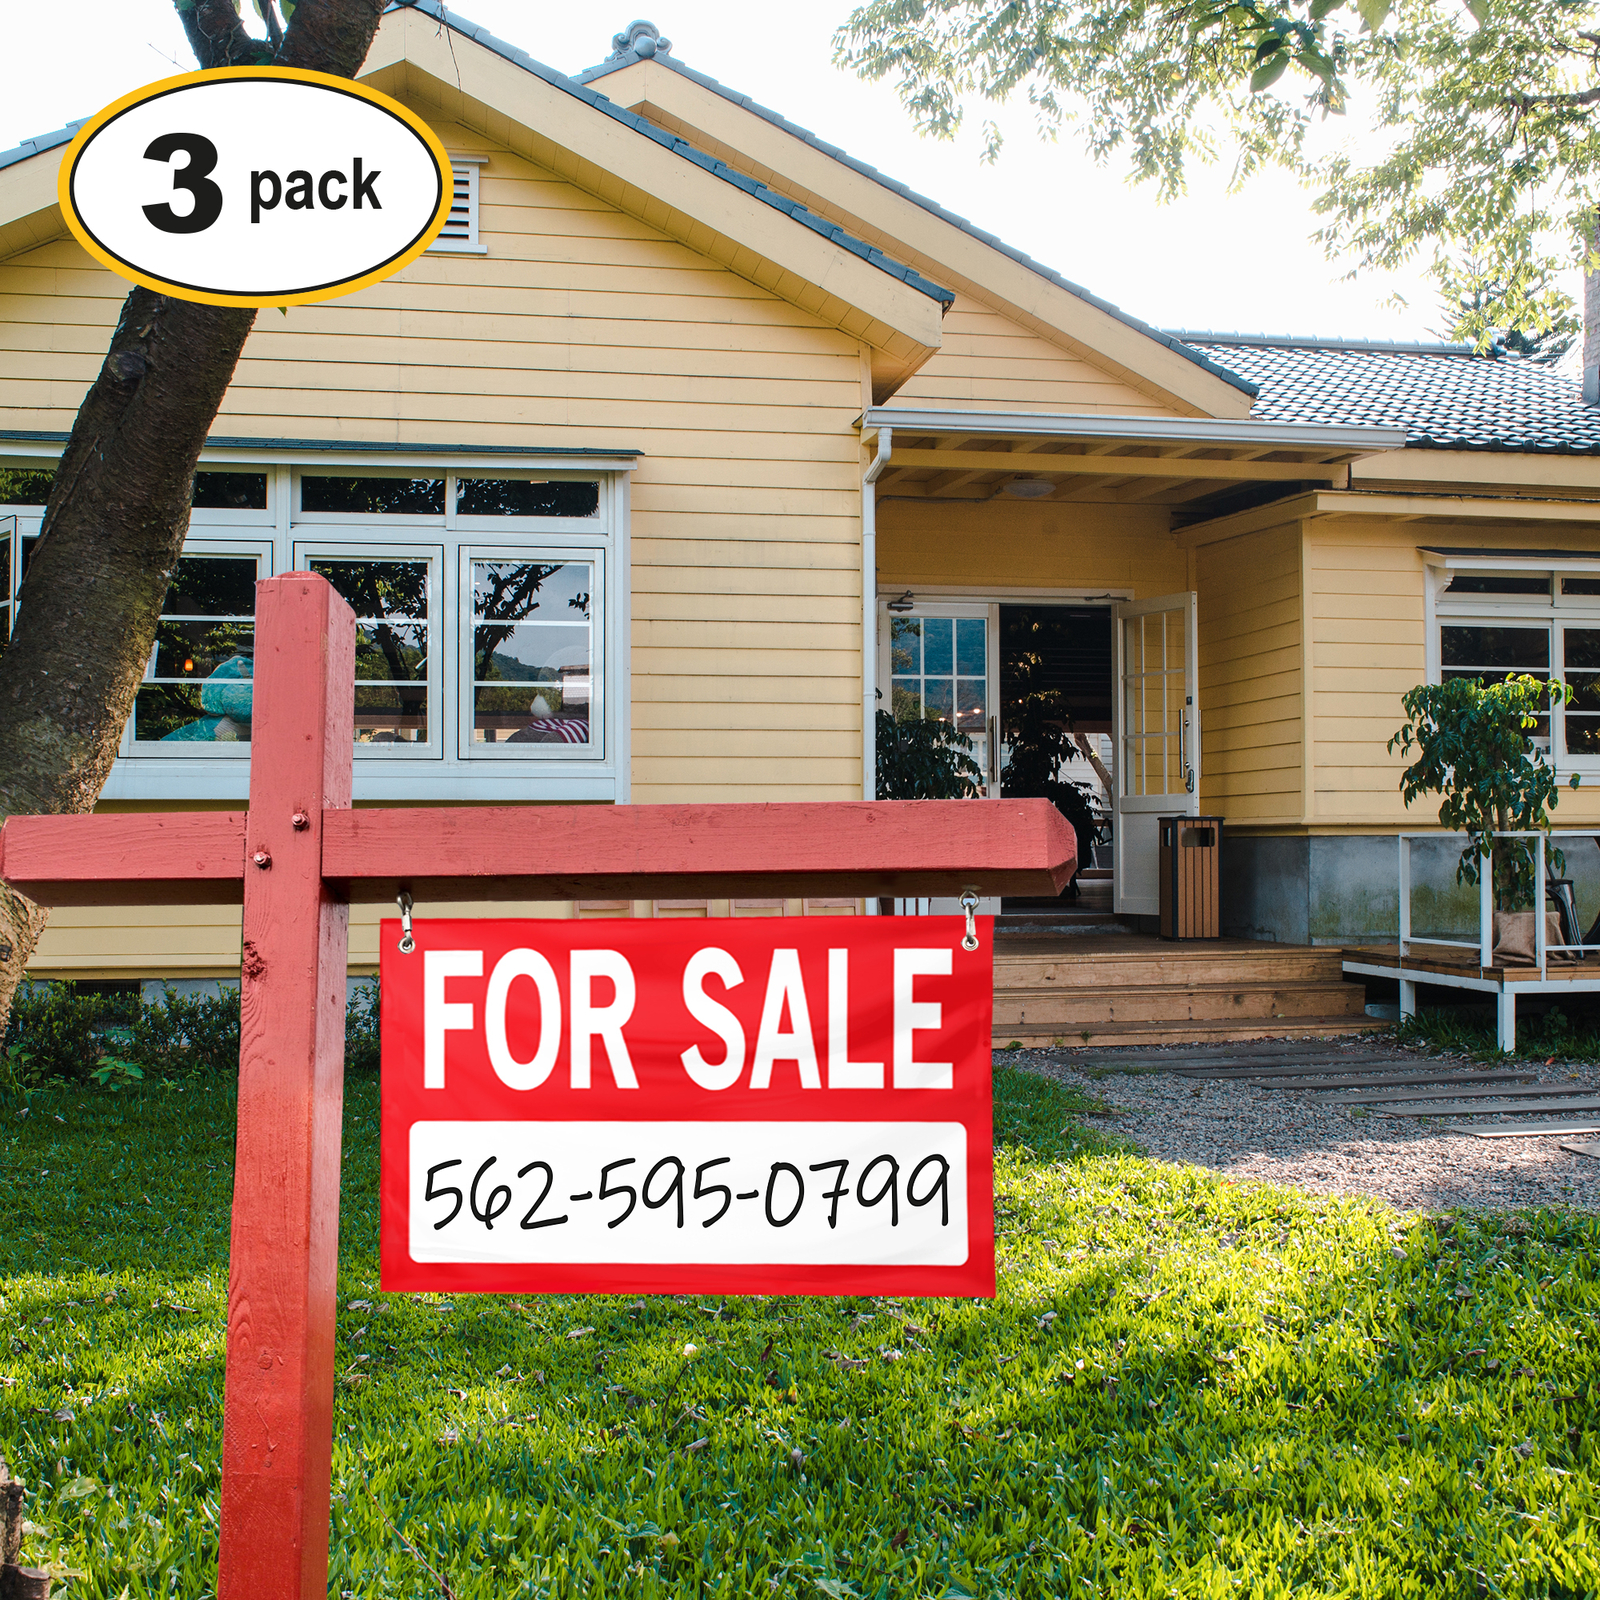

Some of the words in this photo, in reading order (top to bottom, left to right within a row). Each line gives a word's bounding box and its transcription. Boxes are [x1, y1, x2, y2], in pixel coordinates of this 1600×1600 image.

[424, 948, 639, 1090] FOR
[681, 948, 953, 1090] SALE
[425, 1154, 950, 1230] 562-595-0799
